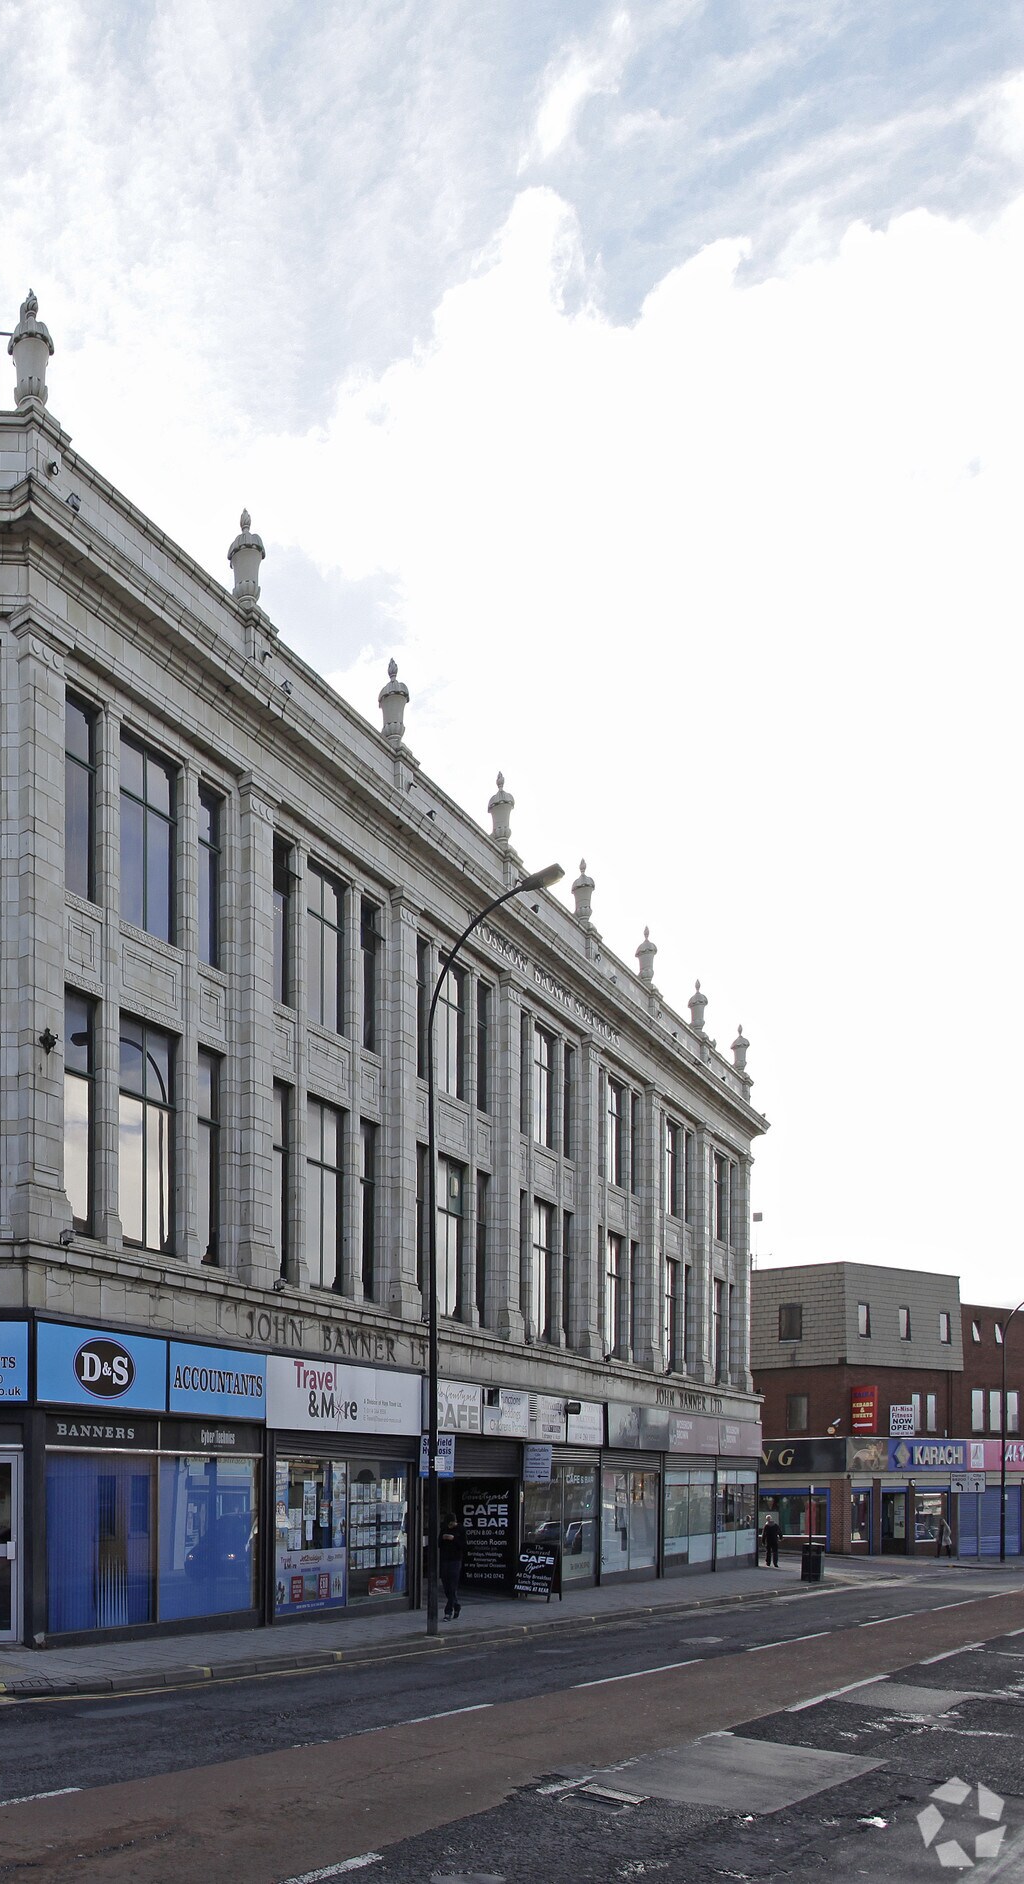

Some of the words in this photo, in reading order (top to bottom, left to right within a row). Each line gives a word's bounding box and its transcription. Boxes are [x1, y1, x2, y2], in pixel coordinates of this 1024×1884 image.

[245, 1310, 303, 1347] JOHN
[322, 1323, 397, 1363] BANNER
[81, 1351, 129, 1386] D&S
[294, 1361, 338, 1392] Travel
[174, 1365, 263, 1398] ACCOUNTANTS
[655, 1388, 675, 1406] JOHN
[679, 1391, 707, 1411] BANNER
[56, 1422, 135, 1440] BANNERS
[201, 1429, 215, 1445] Cyber
[912, 1445, 964, 1465] KARACHI
[463, 1504, 508, 1515] CAFE
[463, 1518, 473, 1527] &
[477, 1518, 508, 1527] BAR
[520, 1555, 555, 1565] CAFE
